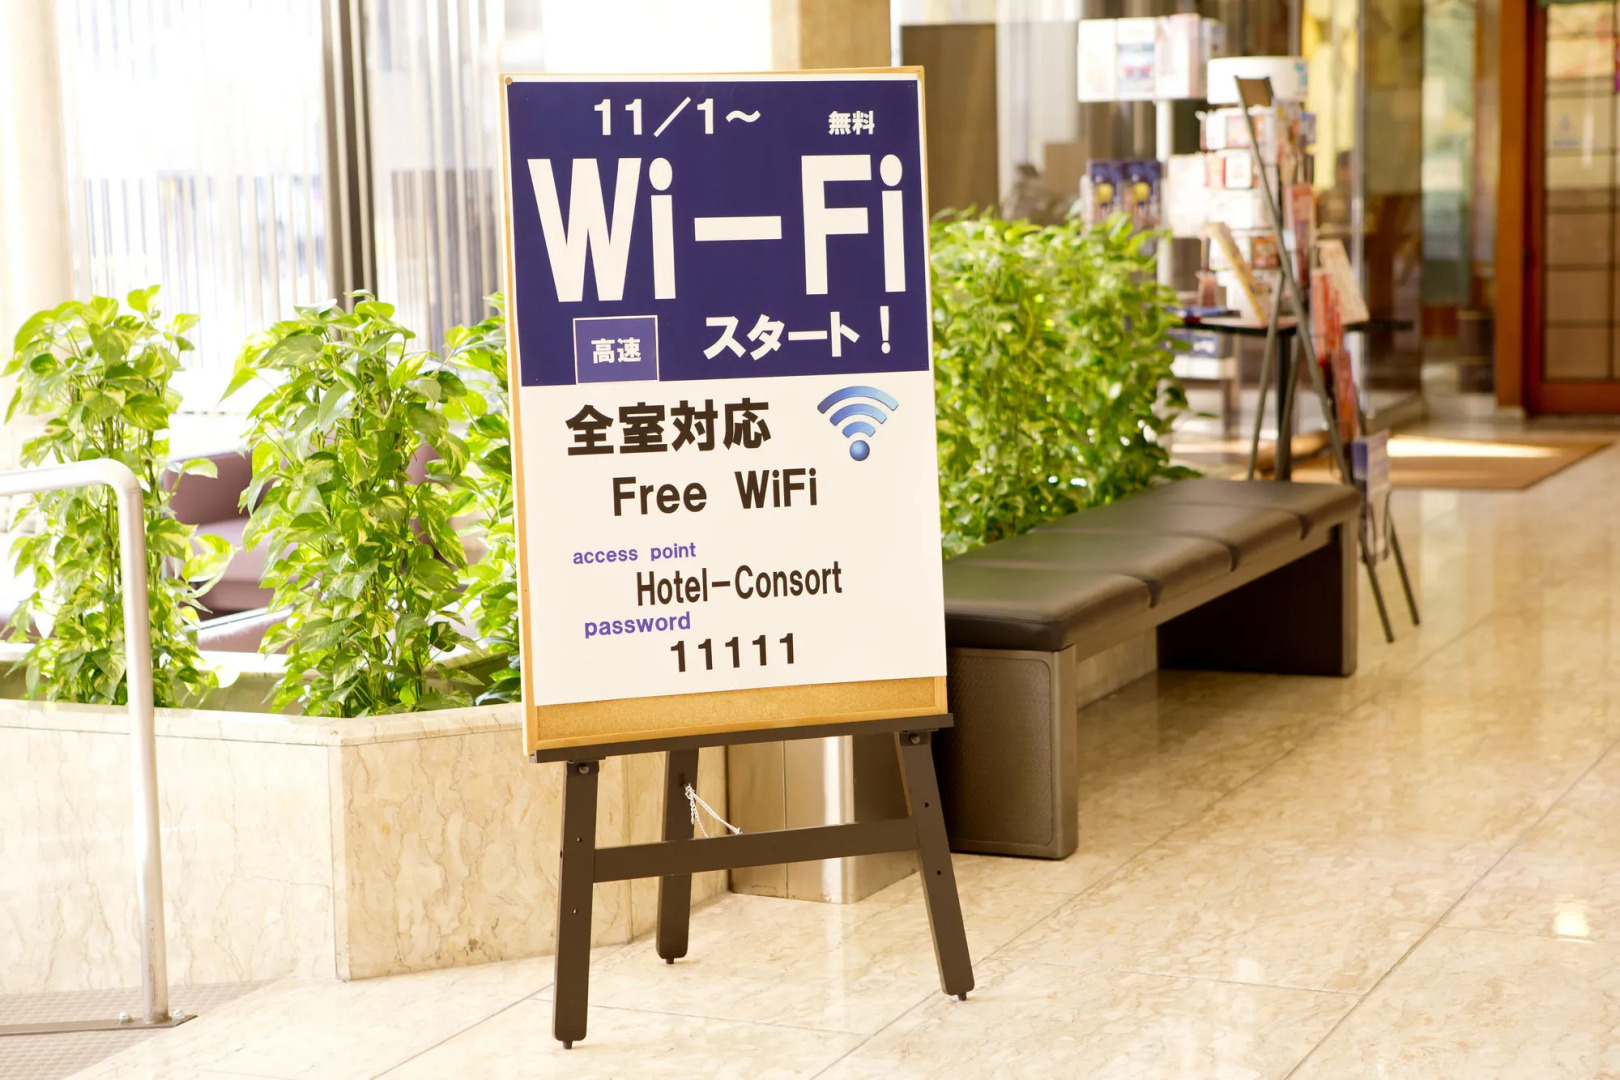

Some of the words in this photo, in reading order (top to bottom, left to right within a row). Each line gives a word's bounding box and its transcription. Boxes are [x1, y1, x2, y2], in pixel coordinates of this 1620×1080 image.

[828, 110, 875, 135] 無料
[591, 337, 642, 363] 高速
[565, 397, 771, 456] 全室対応
[613, 476, 707, 516] Free
[735, 468, 818, 509] WiFi
[573, 548, 638, 564] access
[650, 542, 697, 561] point
[636, 561, 843, 606] Hotel-Consort
[584, 611, 691, 639] password
[670, 632, 795, 672] 11111
